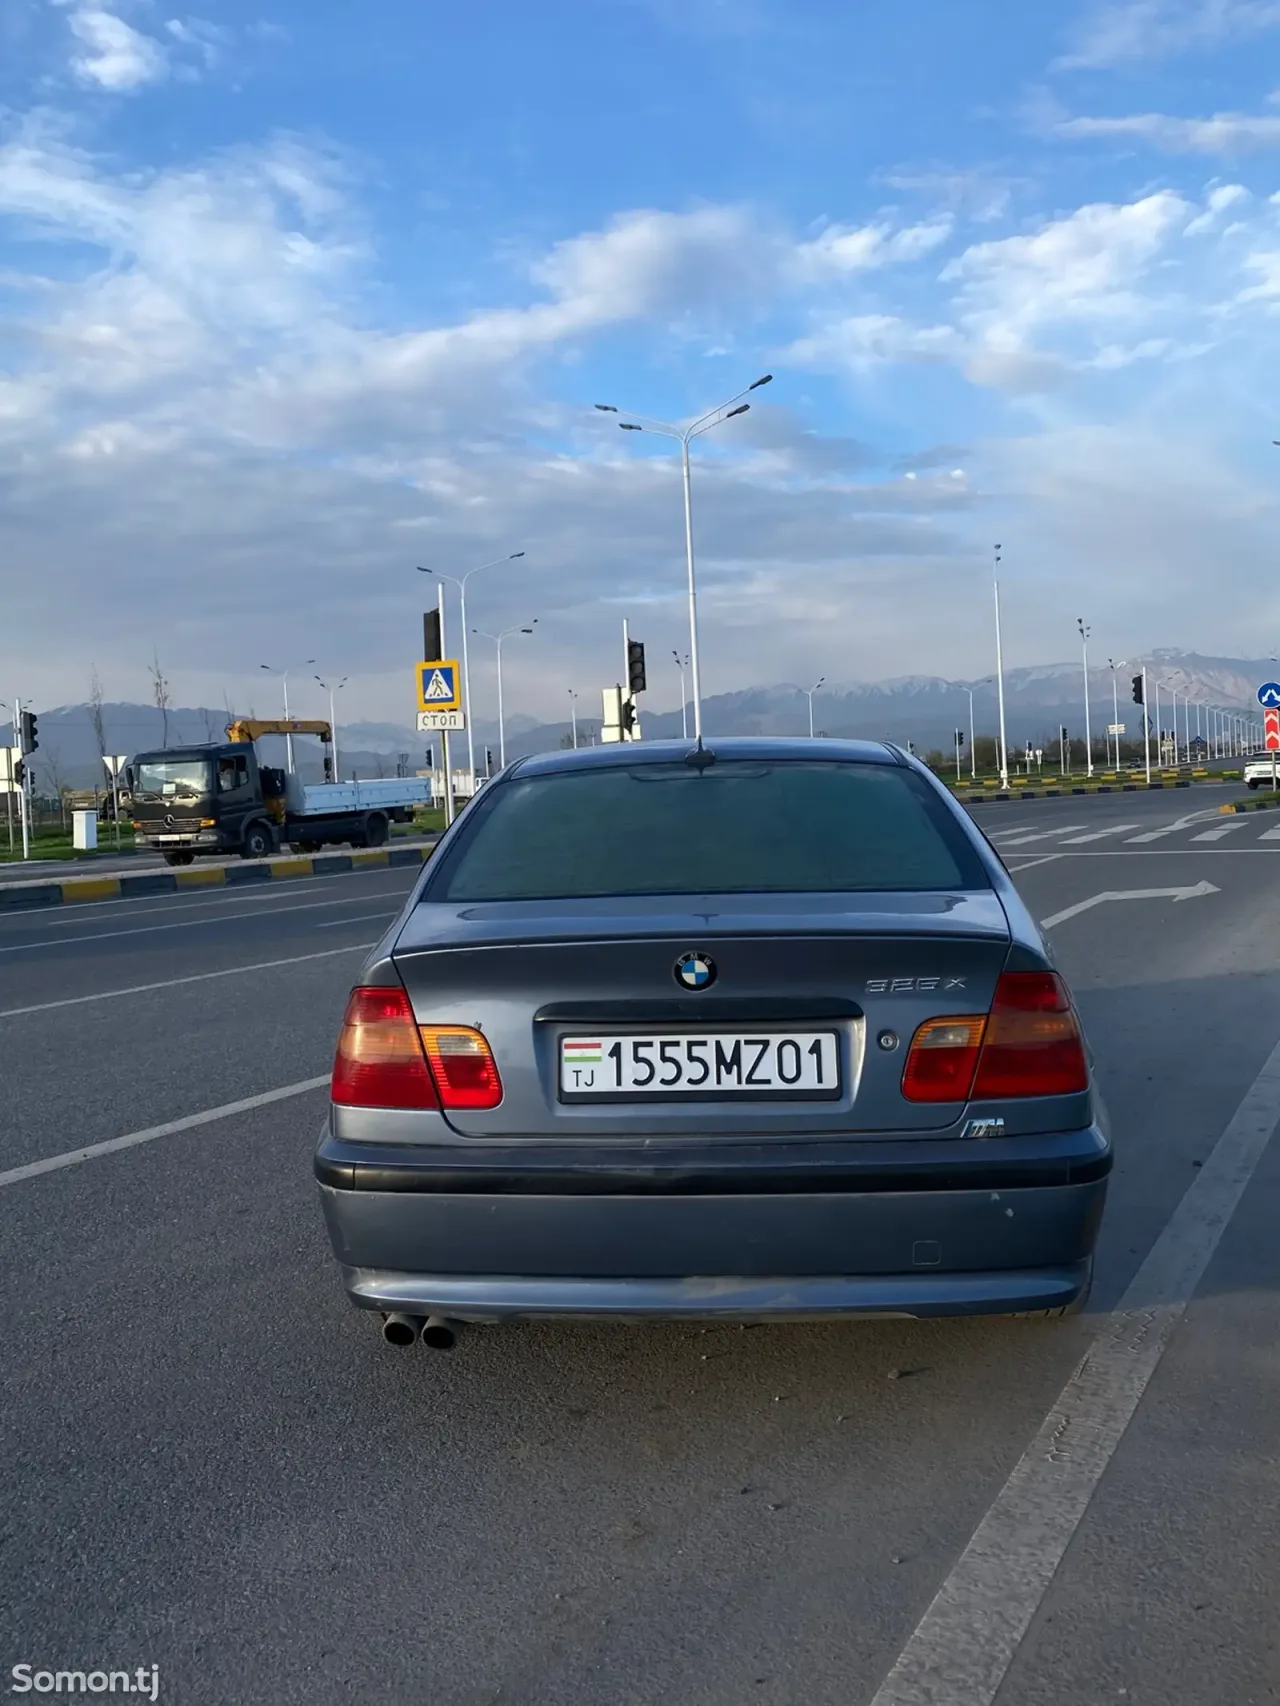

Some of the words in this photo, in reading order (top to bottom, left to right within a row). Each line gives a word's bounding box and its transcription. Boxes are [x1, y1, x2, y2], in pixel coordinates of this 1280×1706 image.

[422, 715, 456, 726] СТОП
[572, 1070, 594, 1087] TJ
[608, 1039, 824, 1087] 1555MZ01
